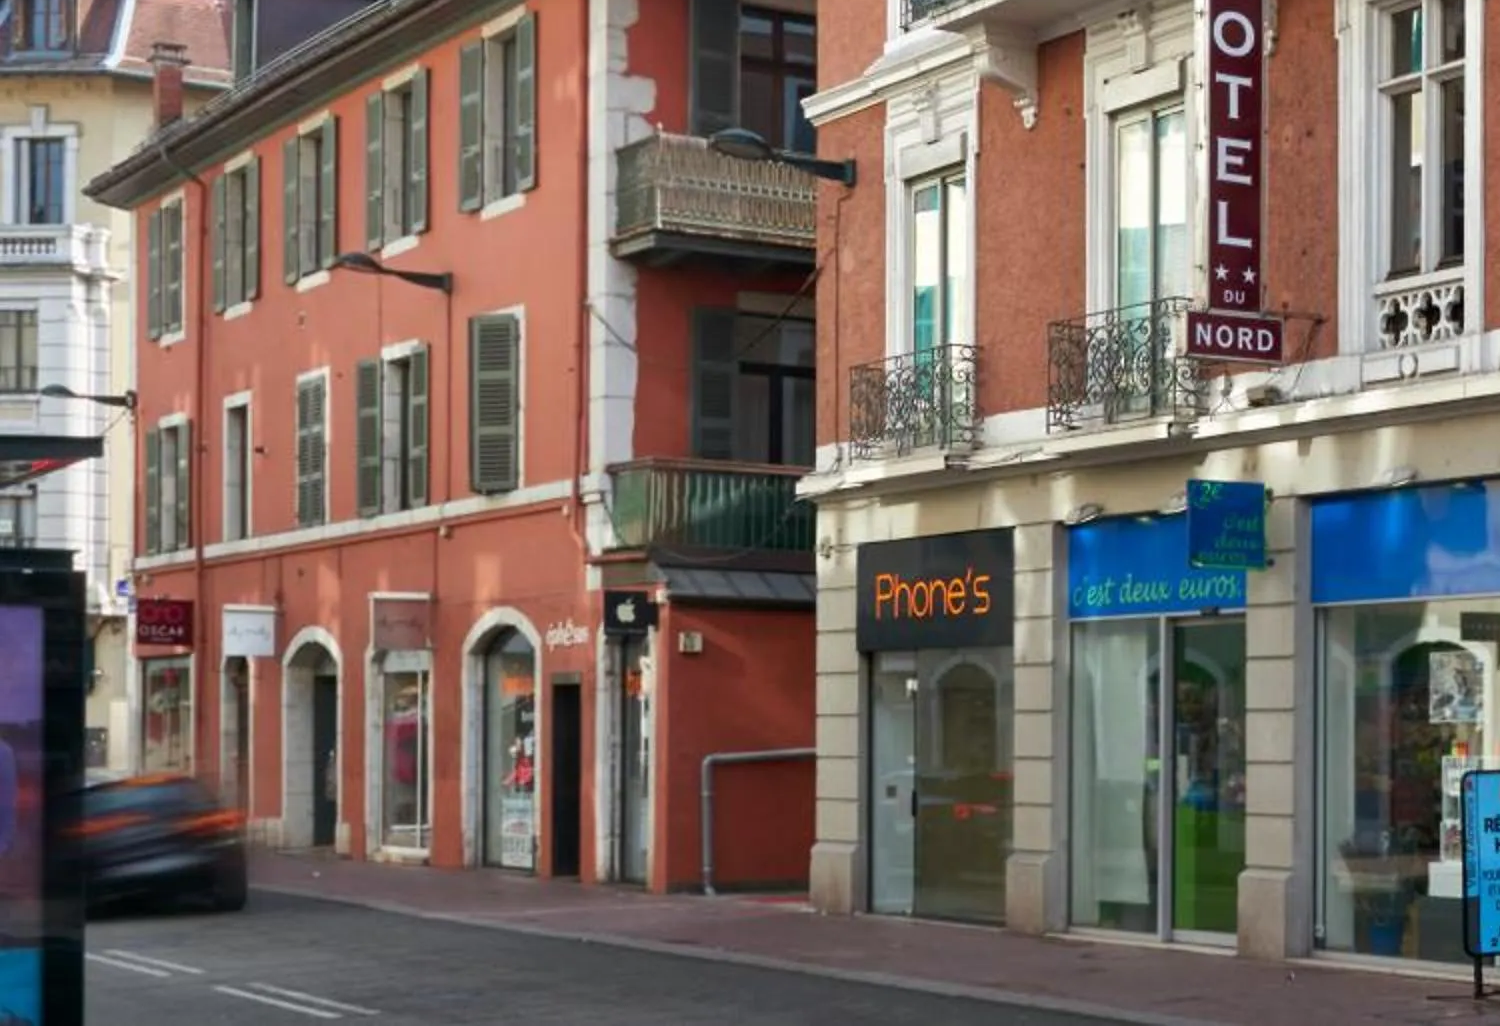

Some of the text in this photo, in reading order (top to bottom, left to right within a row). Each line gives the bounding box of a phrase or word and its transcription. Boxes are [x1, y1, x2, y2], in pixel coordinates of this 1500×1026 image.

[1223, 289, 1246, 305] DU
[1194, 322, 1274, 352] NORD
[874, 566, 991, 620] Phone's
[1073, 576, 1116, 607] c'est
[1119, 573, 1173, 605] deux
